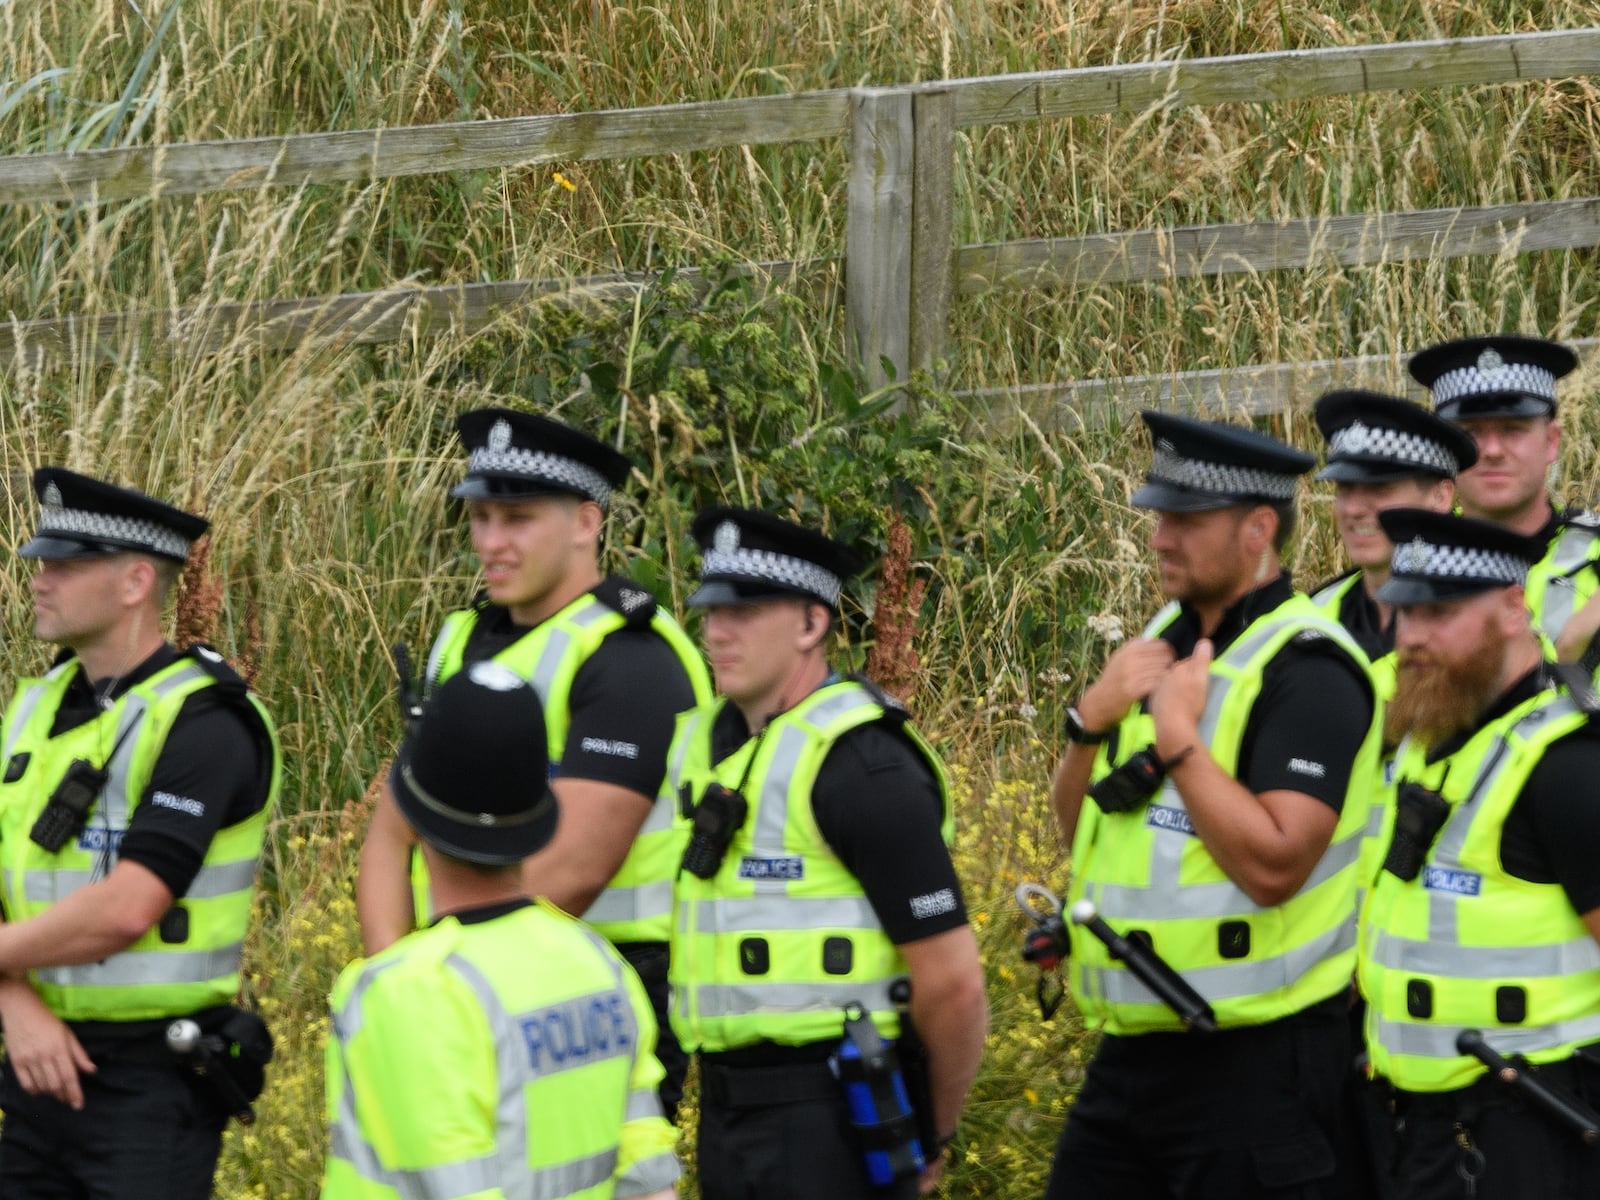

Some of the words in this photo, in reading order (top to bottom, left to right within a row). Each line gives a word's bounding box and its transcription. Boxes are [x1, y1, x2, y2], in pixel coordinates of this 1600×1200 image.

[582, 737, 640, 759] POLICE
[152, 791, 205, 817] POLICE
[1147, 806, 1193, 832] POLIC
[742, 860, 800, 877] POLICE
[1424, 868, 1478, 893] POLICE
[520, 995, 630, 1069] POLICE
